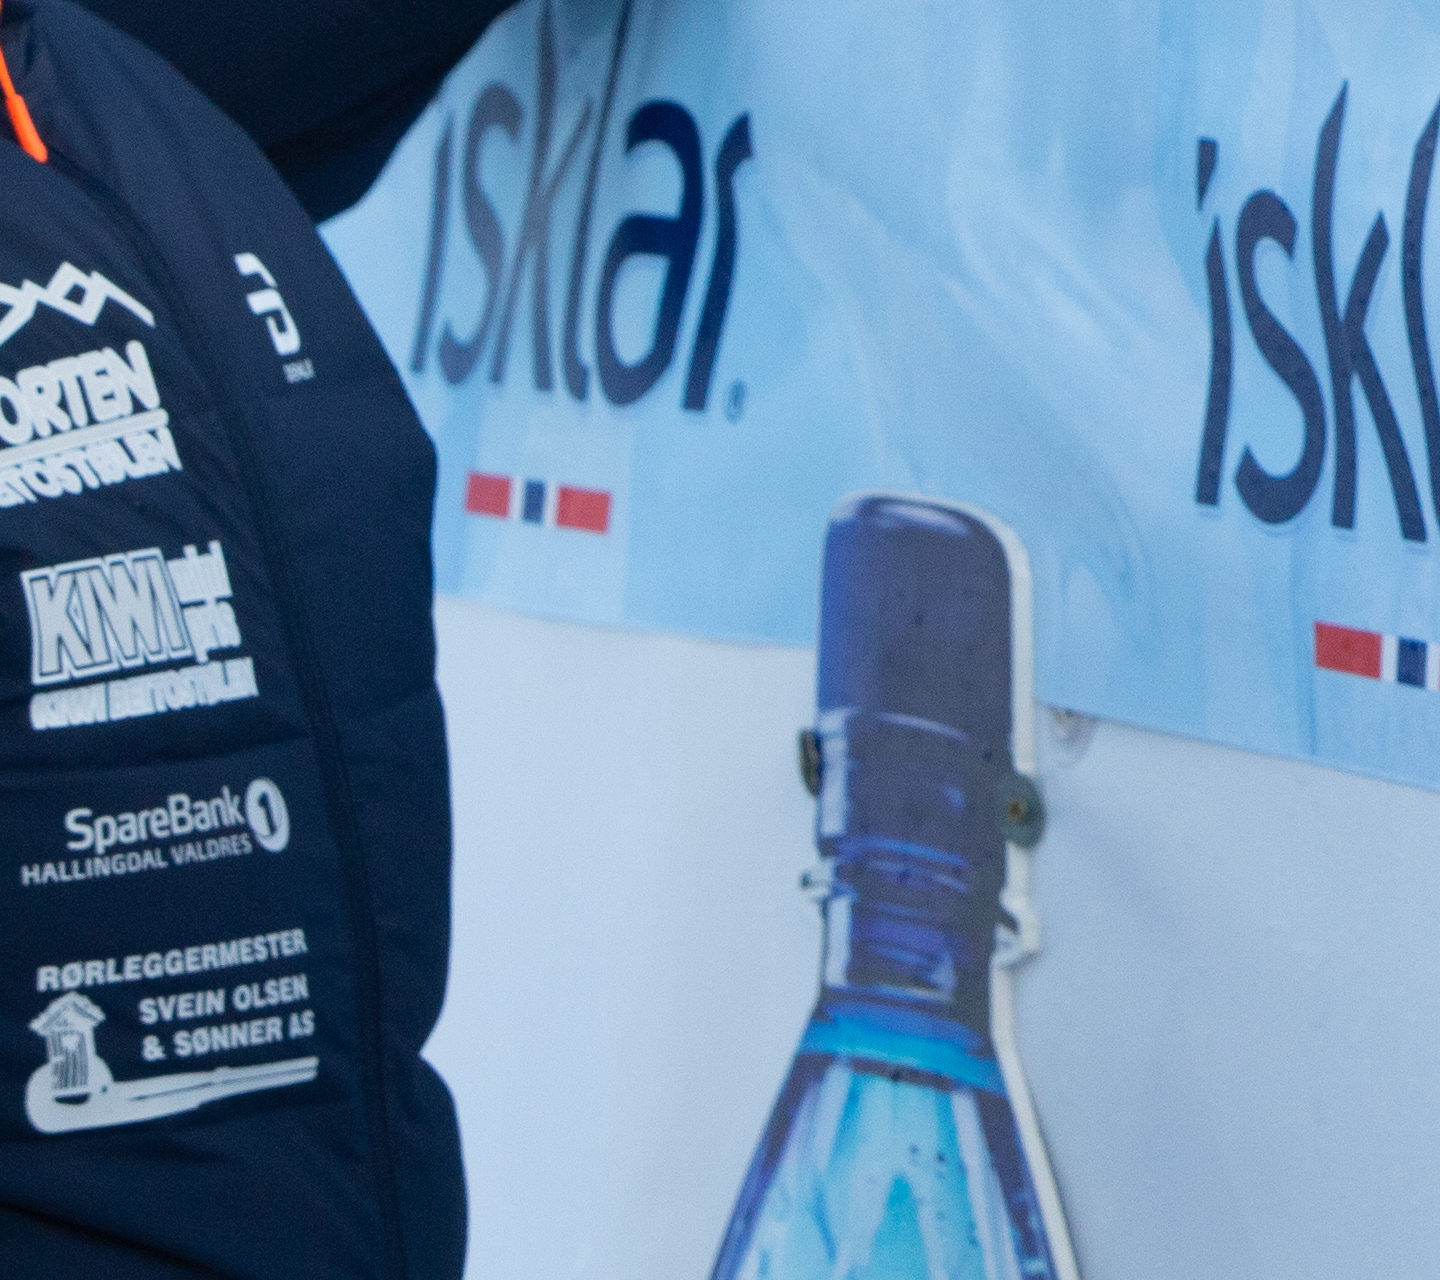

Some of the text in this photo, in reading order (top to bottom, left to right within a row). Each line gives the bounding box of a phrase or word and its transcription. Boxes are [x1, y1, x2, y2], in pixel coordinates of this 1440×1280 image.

[0, 339, 161, 444] ORTEN
[22, 549, 193, 683] KIWI
[64, 785, 283, 854] SpareBank 1
[20, 832, 252, 886] HALLINGDAL VALDRES
[36, 928, 308, 992] RØRLEGGERMESTER
[139, 974, 309, 1026] SVEIN OLSEN
[141, 1009, 316, 1061] & SØNNER AS
